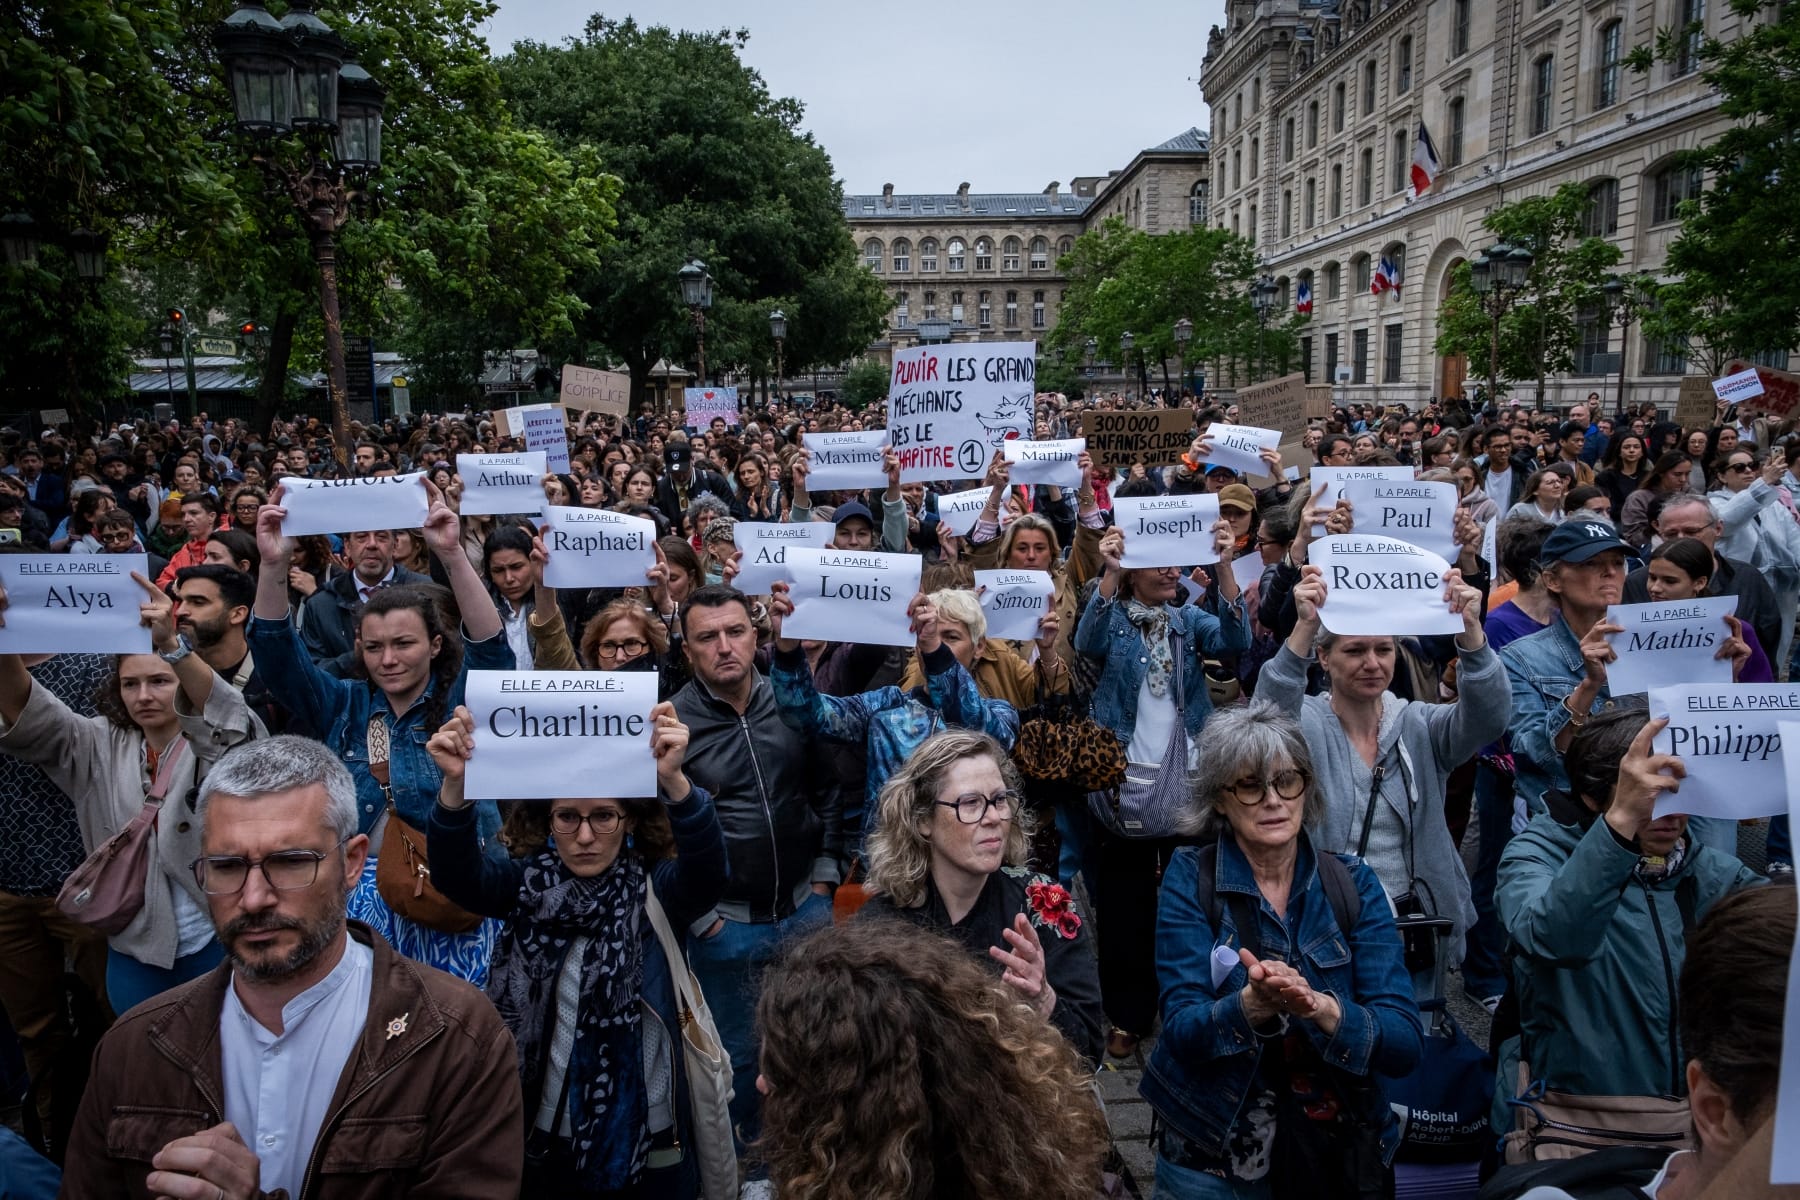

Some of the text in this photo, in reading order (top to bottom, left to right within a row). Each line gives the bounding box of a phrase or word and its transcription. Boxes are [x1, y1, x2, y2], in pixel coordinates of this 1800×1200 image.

[576, 370, 613, 385] ETAT
[947, 357, 977, 382] LES
[984, 357, 1035, 383] GRAND
[1717, 375, 1756, 392] DARMANIN
[565, 383, 627, 403] COMPLICE
[1242, 382, 1290, 403] LYHANNA
[687, 402, 738, 411] LYHANNA
[894, 388, 963, 419] MÉCHANTS
[1094, 415, 1160, 432] 300 000
[892, 423, 933, 448] DÈS LE
[1086, 434, 1147, 451] ENFANTS
[1222, 435, 1258, 453] Jules
[815, 449, 880, 465] Maxime
[962, 443, 979, 466] 1
[1022, 449, 1073, 461] Martin
[1102, 452, 1137, 465] SANS
[477, 471, 533, 486] Arthur
[1375, 488, 1383, 497] IL
[1386, 488, 1394, 497] A
[1381, 507, 1432, 528] Paul
[757, 529, 765, 537] IL
[768, 529, 775, 537] A
[1136, 515, 1203, 538] Joseph
[553, 531, 644, 556] Raphaël
[1332, 543, 1361, 553] ELLE
[1366, 543, 1375, 553] A
[20, 563, 52, 573] ELLE
[57, 563, 66, 573] A
[69, 561, 113, 573] PARLÉ
[820, 555, 830, 565] IL
[830, 556, 841, 565] A
[844, 557, 882, 567] PARLÉ
[1331, 565, 1439, 590] Roxane
[820, 575, 892, 602] Louis
[44, 585, 114, 614] Alya
[992, 592, 1042, 611] Simon
[1641, 611, 1650, 621] IL
[1653, 610, 1662, 620] A
[1664, 606, 1701, 619] PARLÉ
[1628, 627, 1715, 652] Mathis
[501, 680, 542, 691] ELLE
[546, 680, 557, 690] A
[562, 678, 615, 690] PARLÉ
[1688, 692, 1799, 709] ELLE A PARLÉ
[489, 705, 644, 738] Charline
[1412, 1108, 1458, 1124] Hôpital
